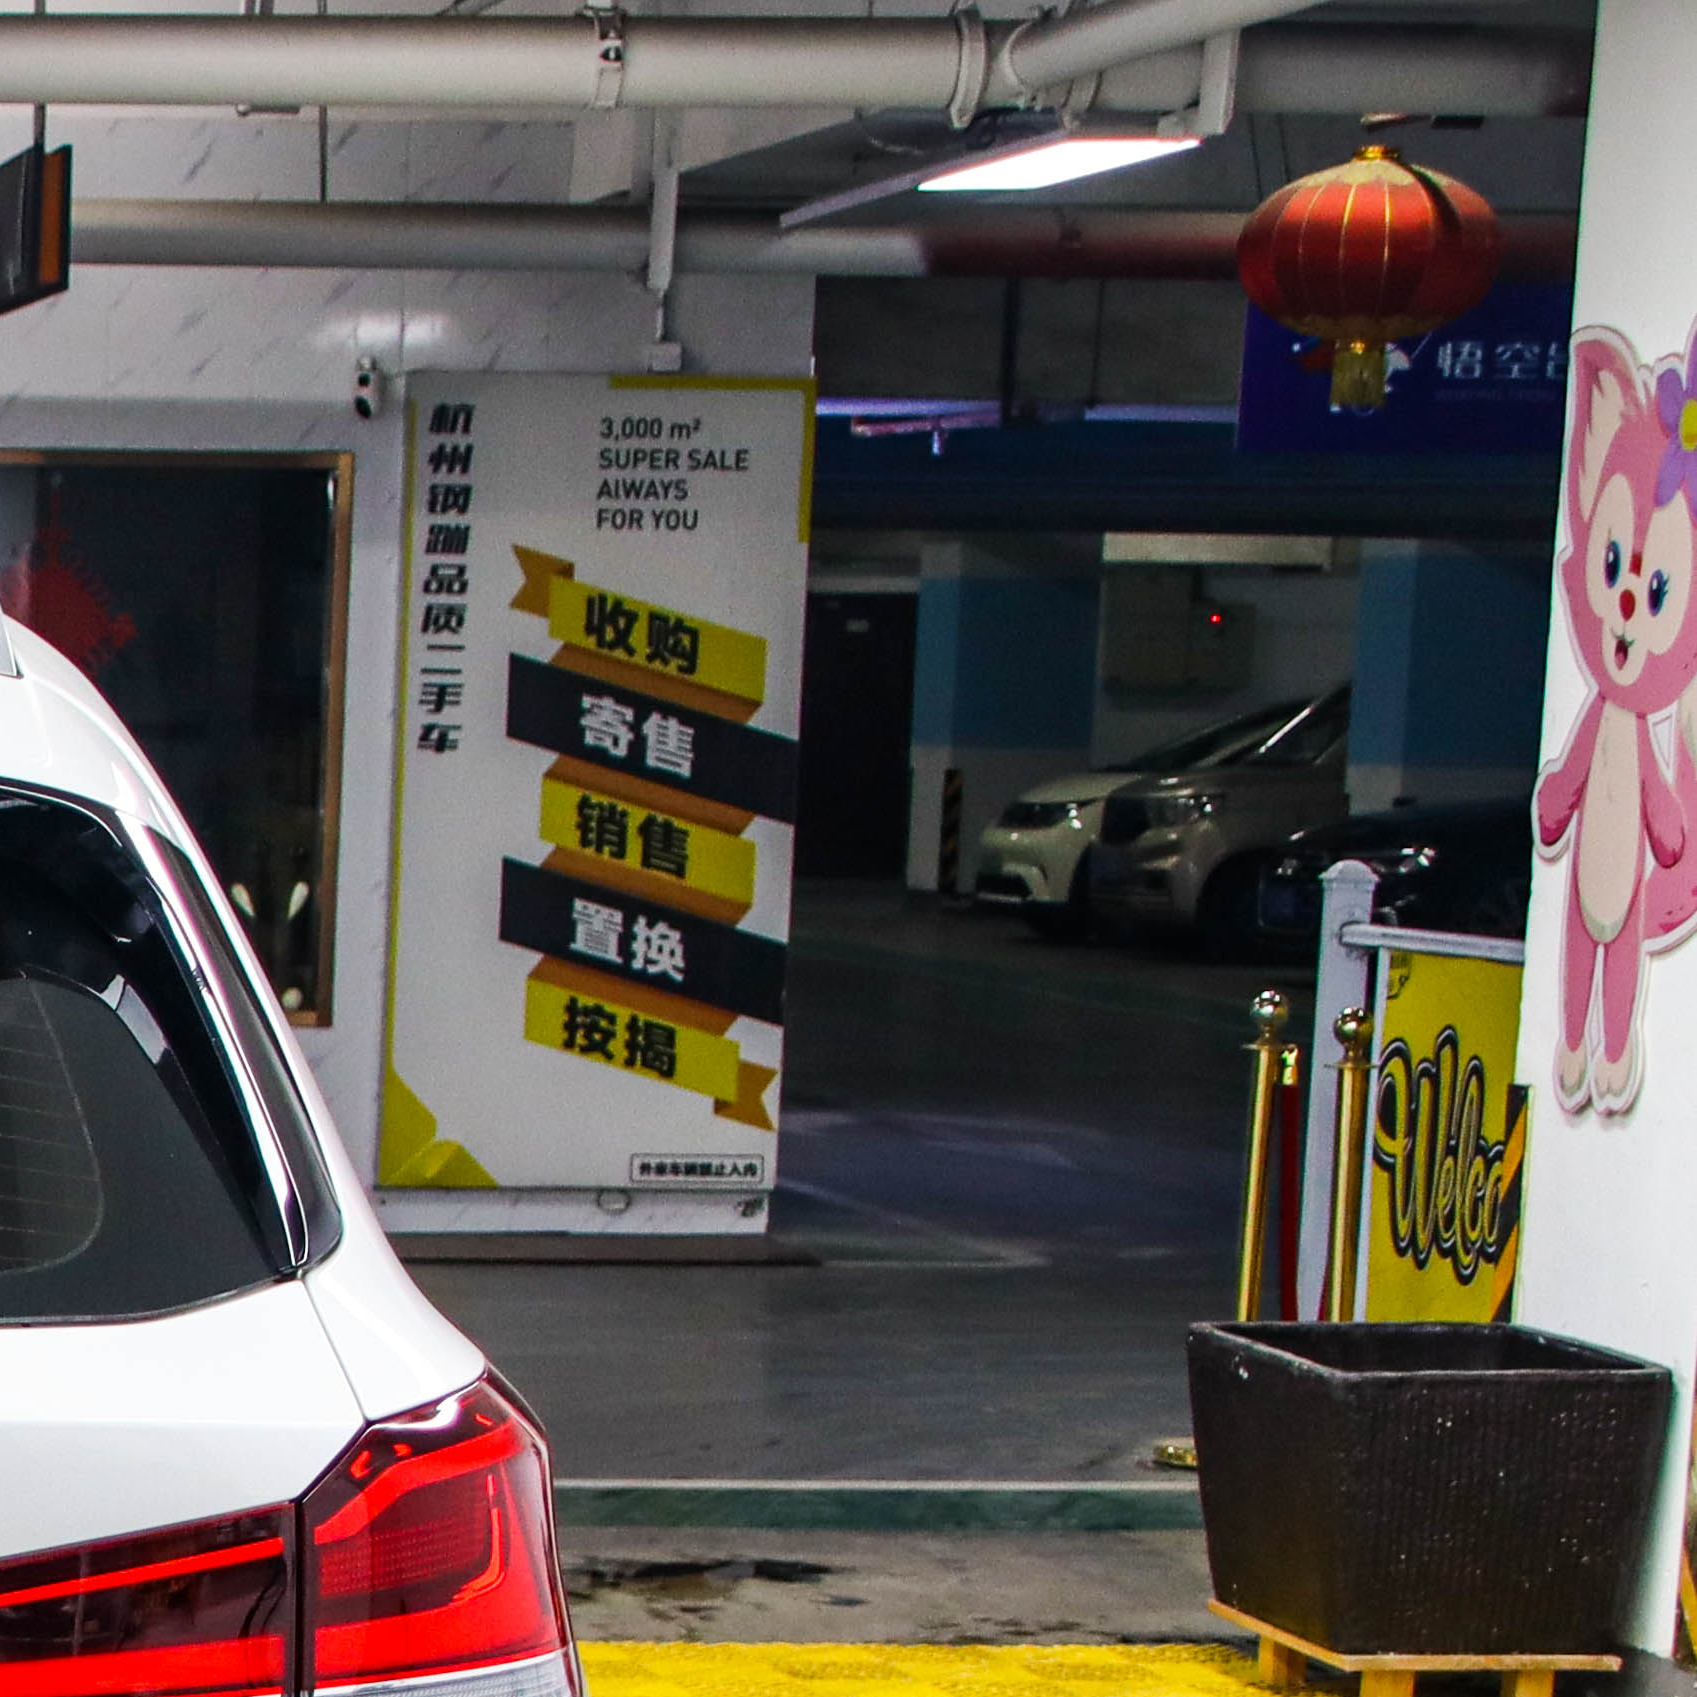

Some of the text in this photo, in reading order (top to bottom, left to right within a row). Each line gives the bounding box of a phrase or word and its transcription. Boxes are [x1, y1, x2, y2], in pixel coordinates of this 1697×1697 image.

[598, 448, 749, 472] SUPER SALE
[599, 415, 663, 441] 3,000
[596, 507, 698, 531] FOR YOU
[584, 593, 700, 675] 收购
[579, 692, 696, 780] 寄售
[576, 794, 690, 879] 销售
[569, 897, 685, 982] 置换
[562, 996, 677, 1078] 按揭
